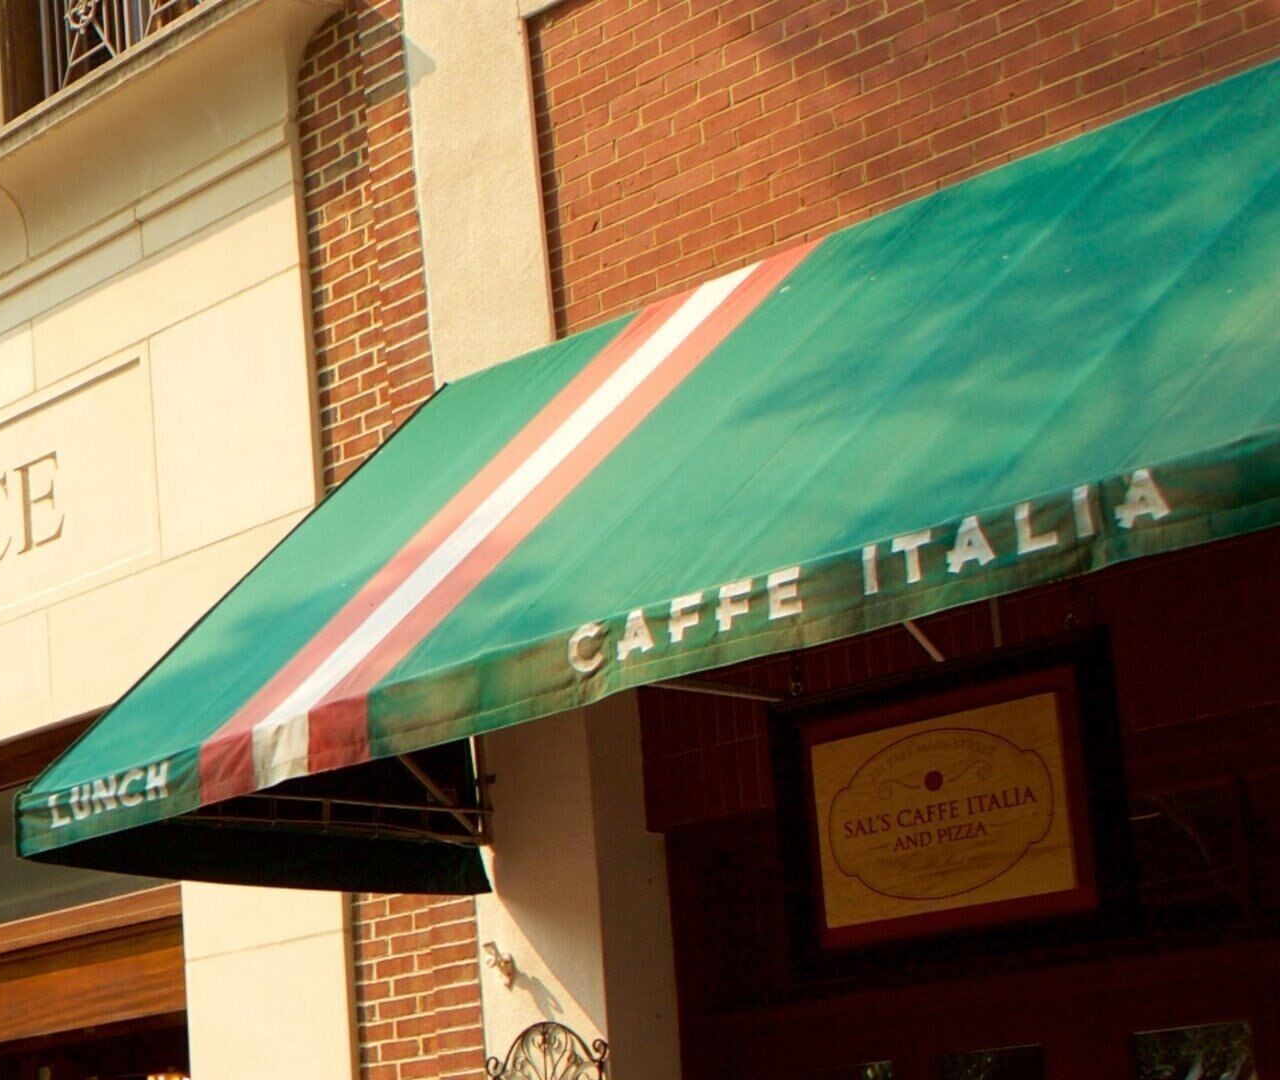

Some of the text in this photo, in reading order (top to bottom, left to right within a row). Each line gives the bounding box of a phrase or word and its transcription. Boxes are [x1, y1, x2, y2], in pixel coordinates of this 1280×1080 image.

[567, 468, 1171, 676] CAFFE ITALIA
[48, 760, 171, 829] LUNCH
[843, 786, 1038, 840] SAL'S CAFFE ITALIA
[893, 821, 988, 852] AND PIZZA
